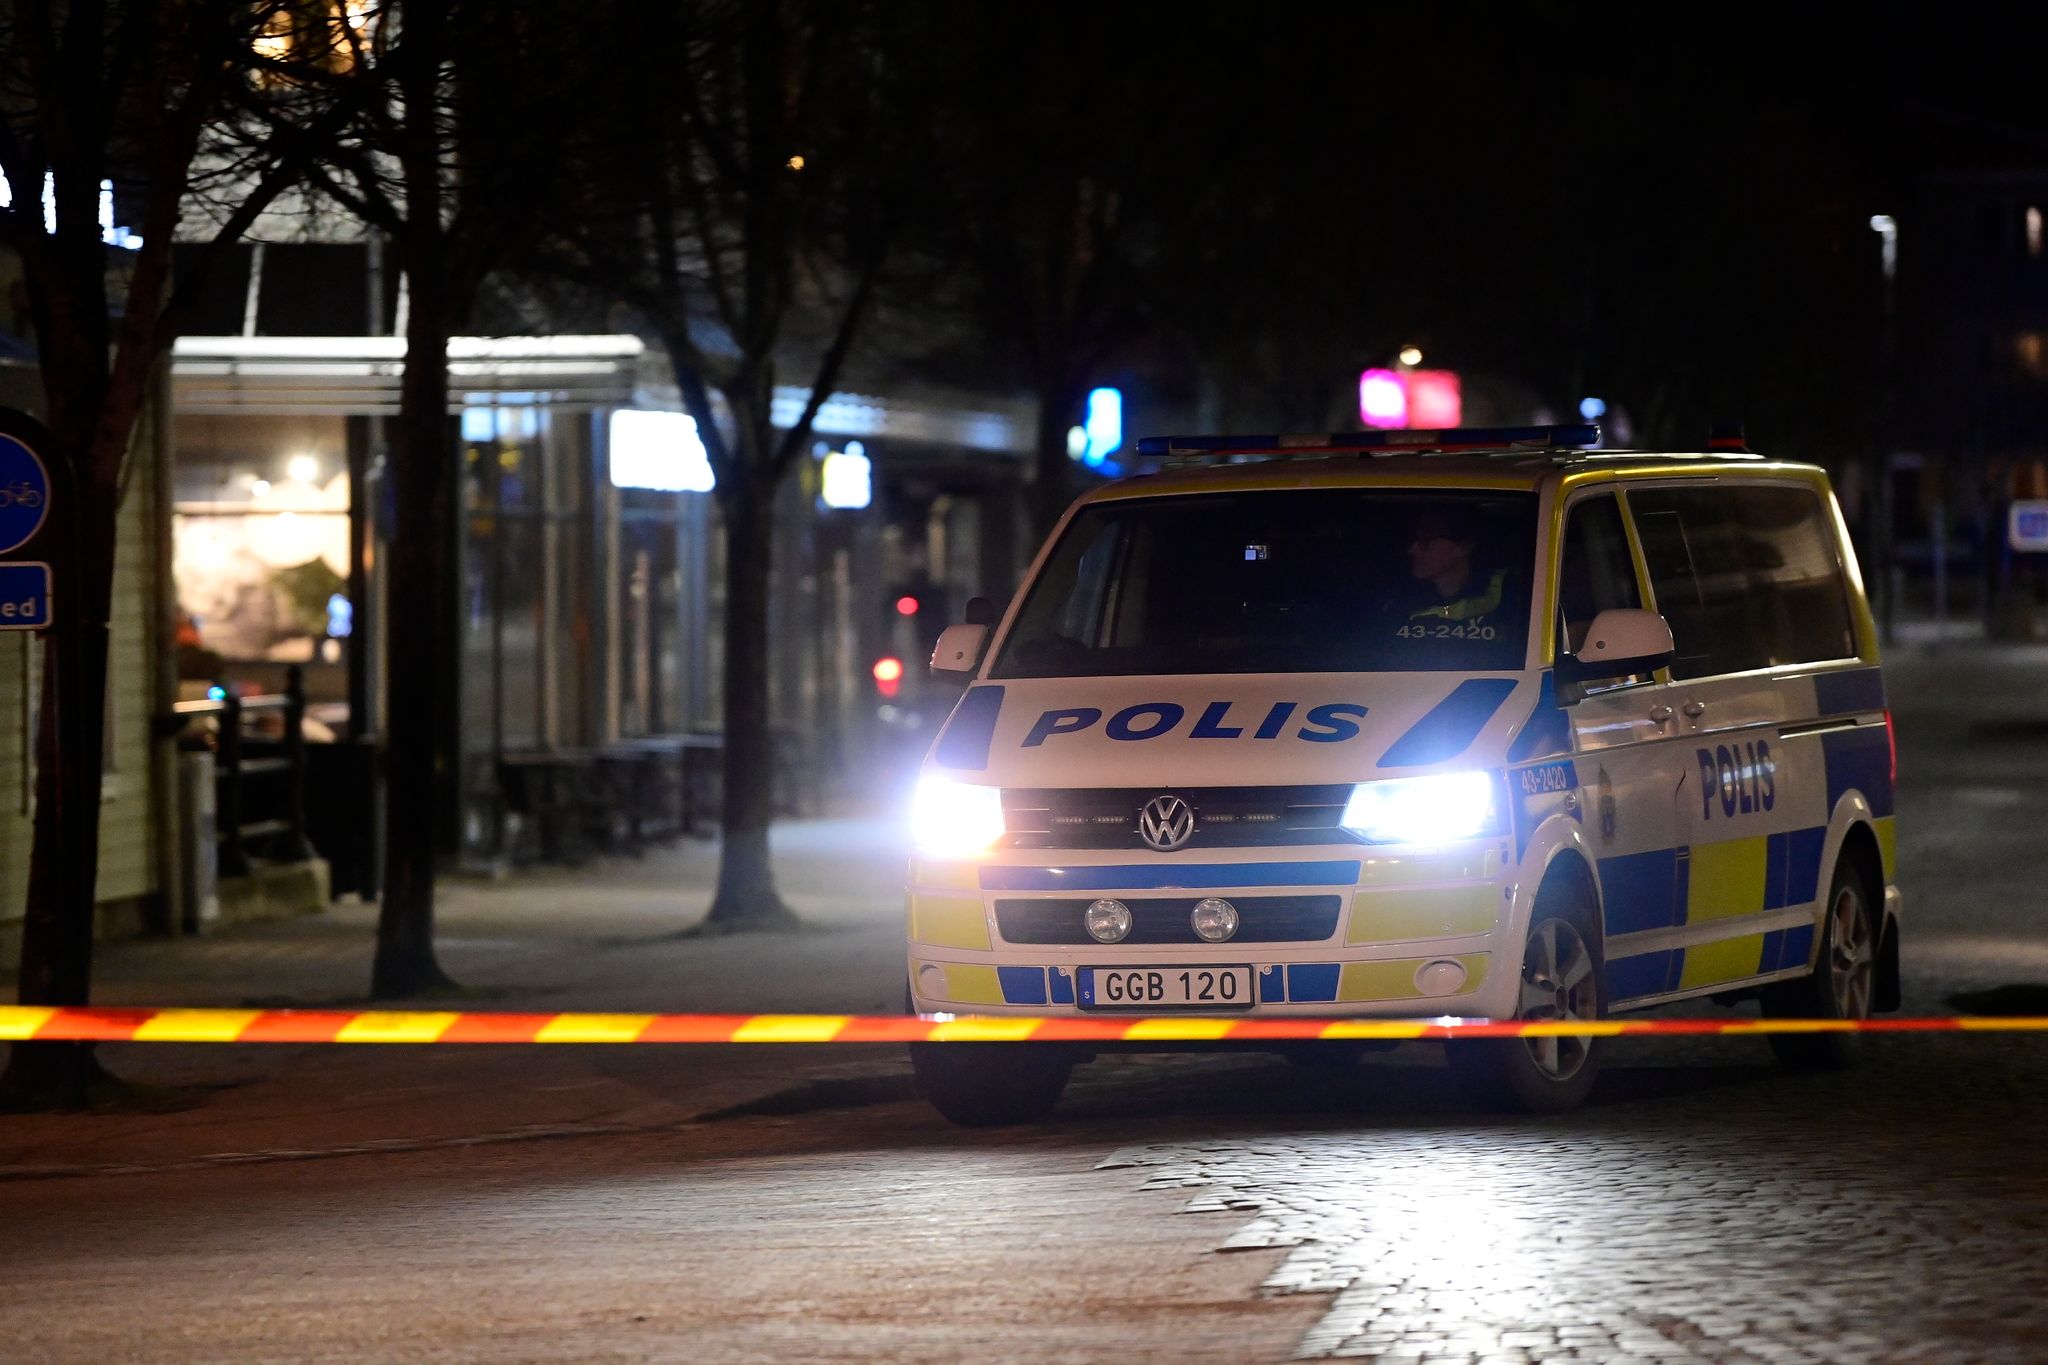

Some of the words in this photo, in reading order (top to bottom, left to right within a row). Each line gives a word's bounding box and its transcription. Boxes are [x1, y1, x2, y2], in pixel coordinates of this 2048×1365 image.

[1396, 624, 1496, 641] 43-2420
[1020, 702, 1370, 748] POLIS
[1521, 766, 1567, 793] 43-2420
[1696, 739, 1777, 820] POLIS
[1140, 796, 1194, 852] VW
[1083, 991, 1091, 1000] S
[1106, 972, 1165, 1001] GGB
[1179, 971, 1237, 1000] 120
